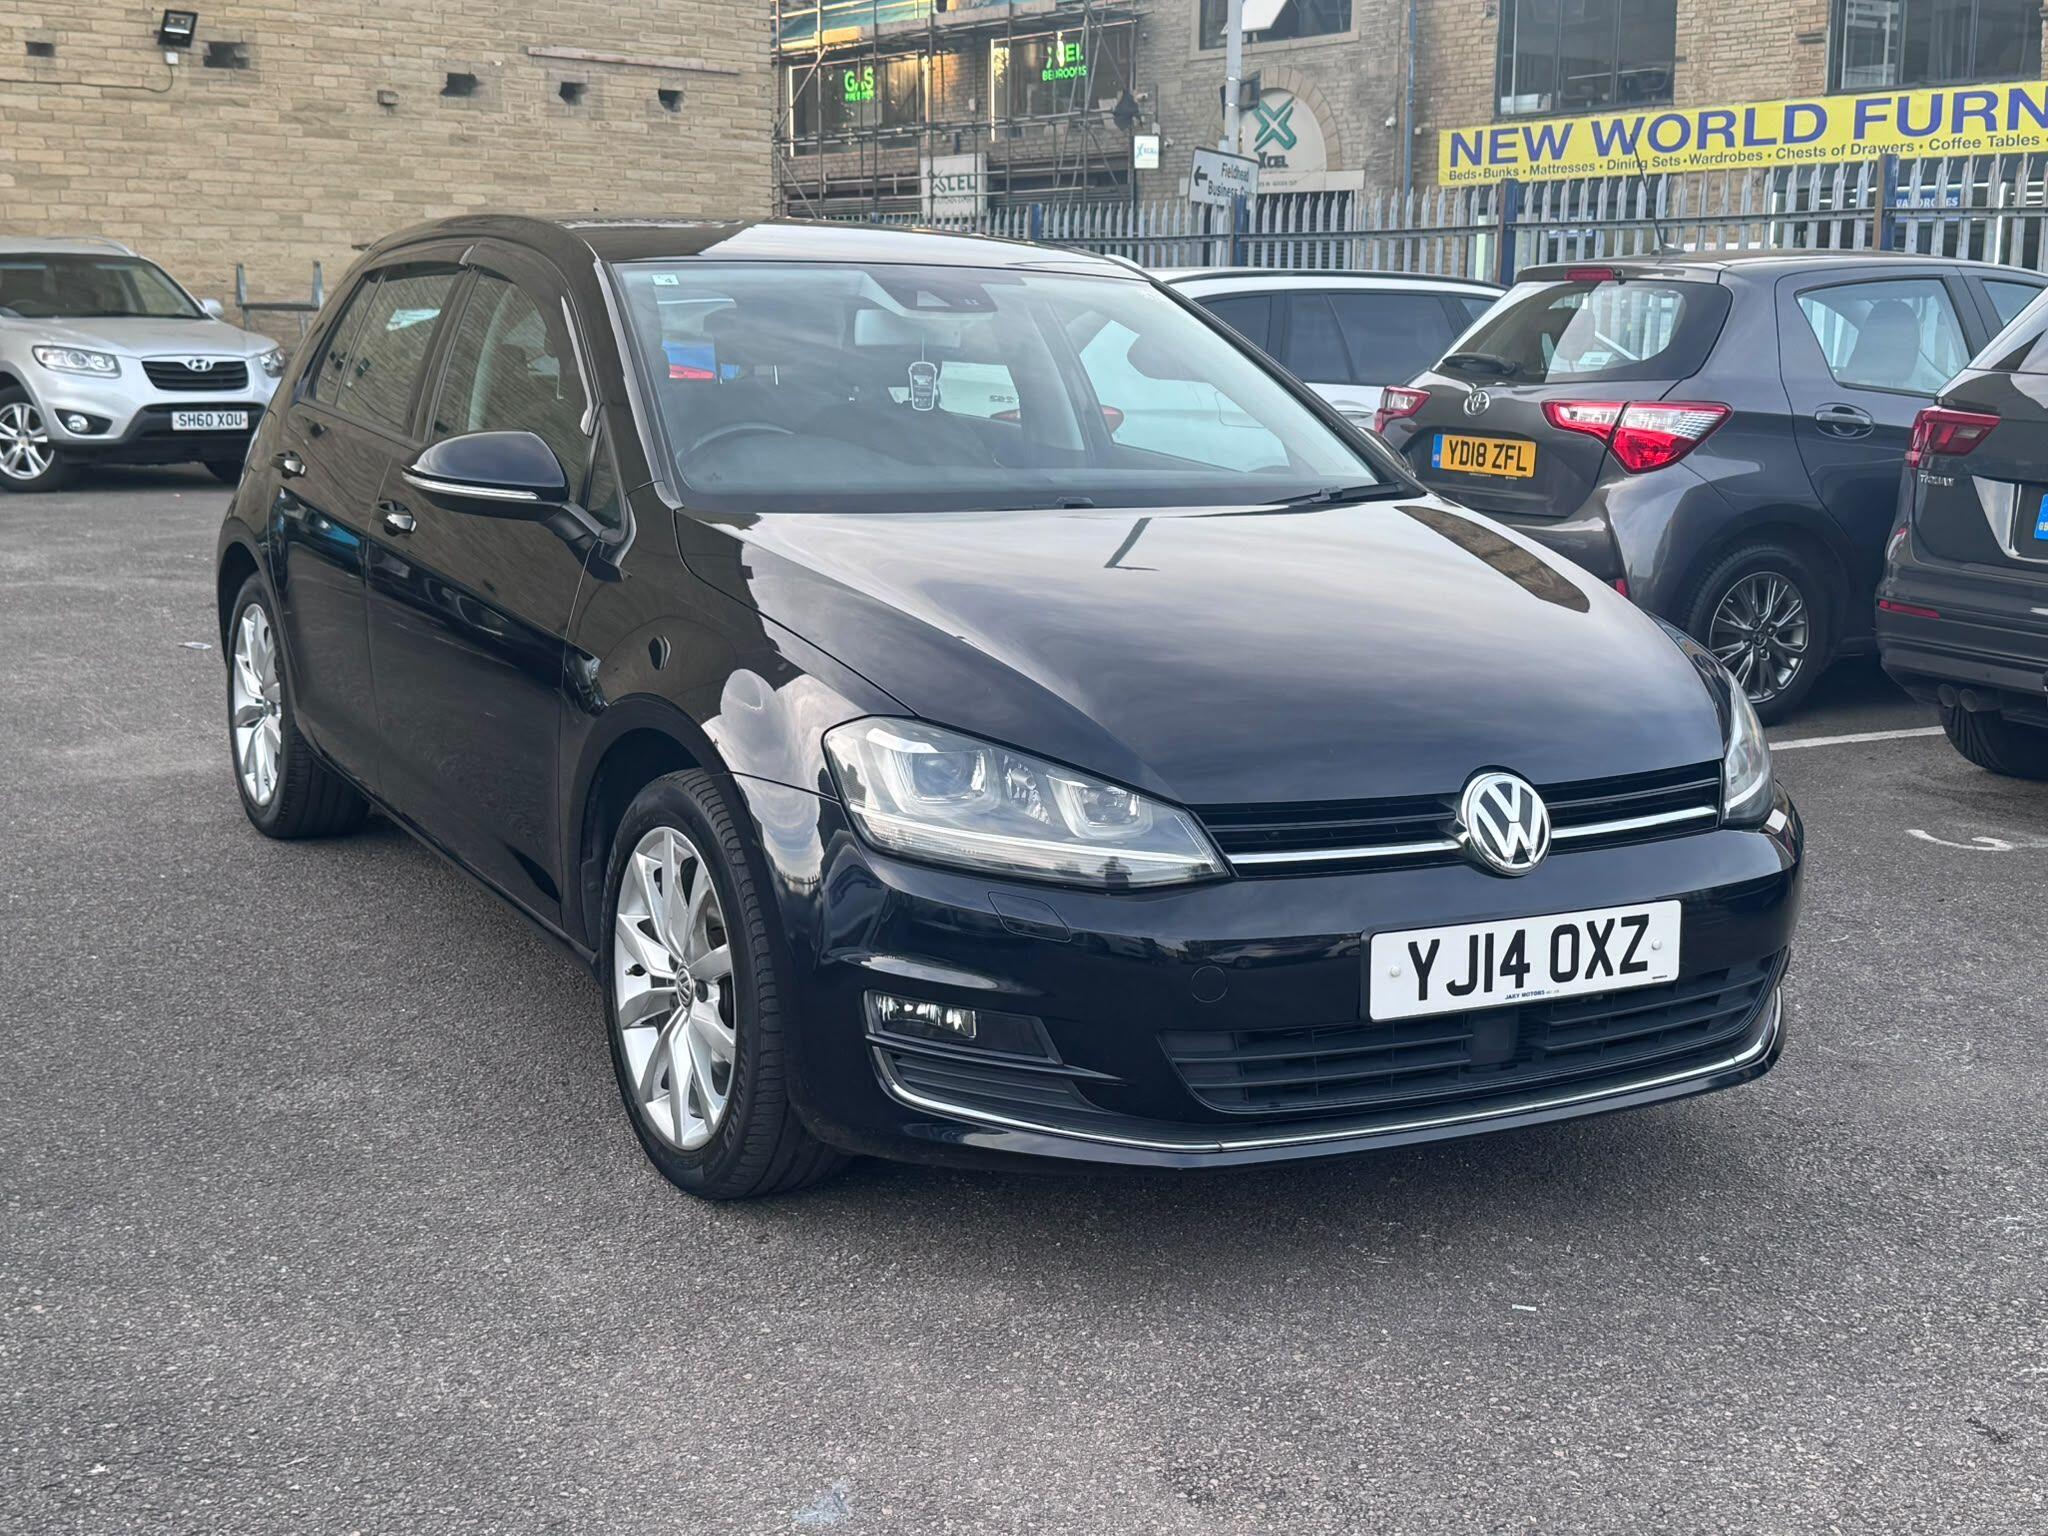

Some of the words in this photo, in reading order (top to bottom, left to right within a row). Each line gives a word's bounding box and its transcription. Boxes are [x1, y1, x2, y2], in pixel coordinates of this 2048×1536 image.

[1450, 122, 1574, 168] NEW
[1591, 103, 1828, 157] WORLD
[1221, 162, 1249, 183] Fieldhead
[1449, 169, 1477, 181] Beds
[1483, 166, 1520, 179] Bunks
[1530, 162, 1596, 176] Mattresses
[1607, 157, 1648, 172] Dining
[1652, 155, 1681, 168] Sets
[1689, 149, 1763, 165] Wardrobes
[1775, 147, 1826, 159] Chests
[1831, 144, 1847, 156] of
[1850, 141, 1915, 155] Drawers
[1928, 136, 1982, 151] Coffee
[1987, 134, 2041, 148] Tables
[1895, 196, 1959, 209] WADROES
[178, 413, 214, 427] SH60
[217, 413, 243, 426] XOU
[1448, 439, 1488, 468] YD18
[1491, 443, 1527, 472] ZFL
[1407, 928, 1531, 1001] YJ14
[1549, 913, 1650, 984] OXZ
